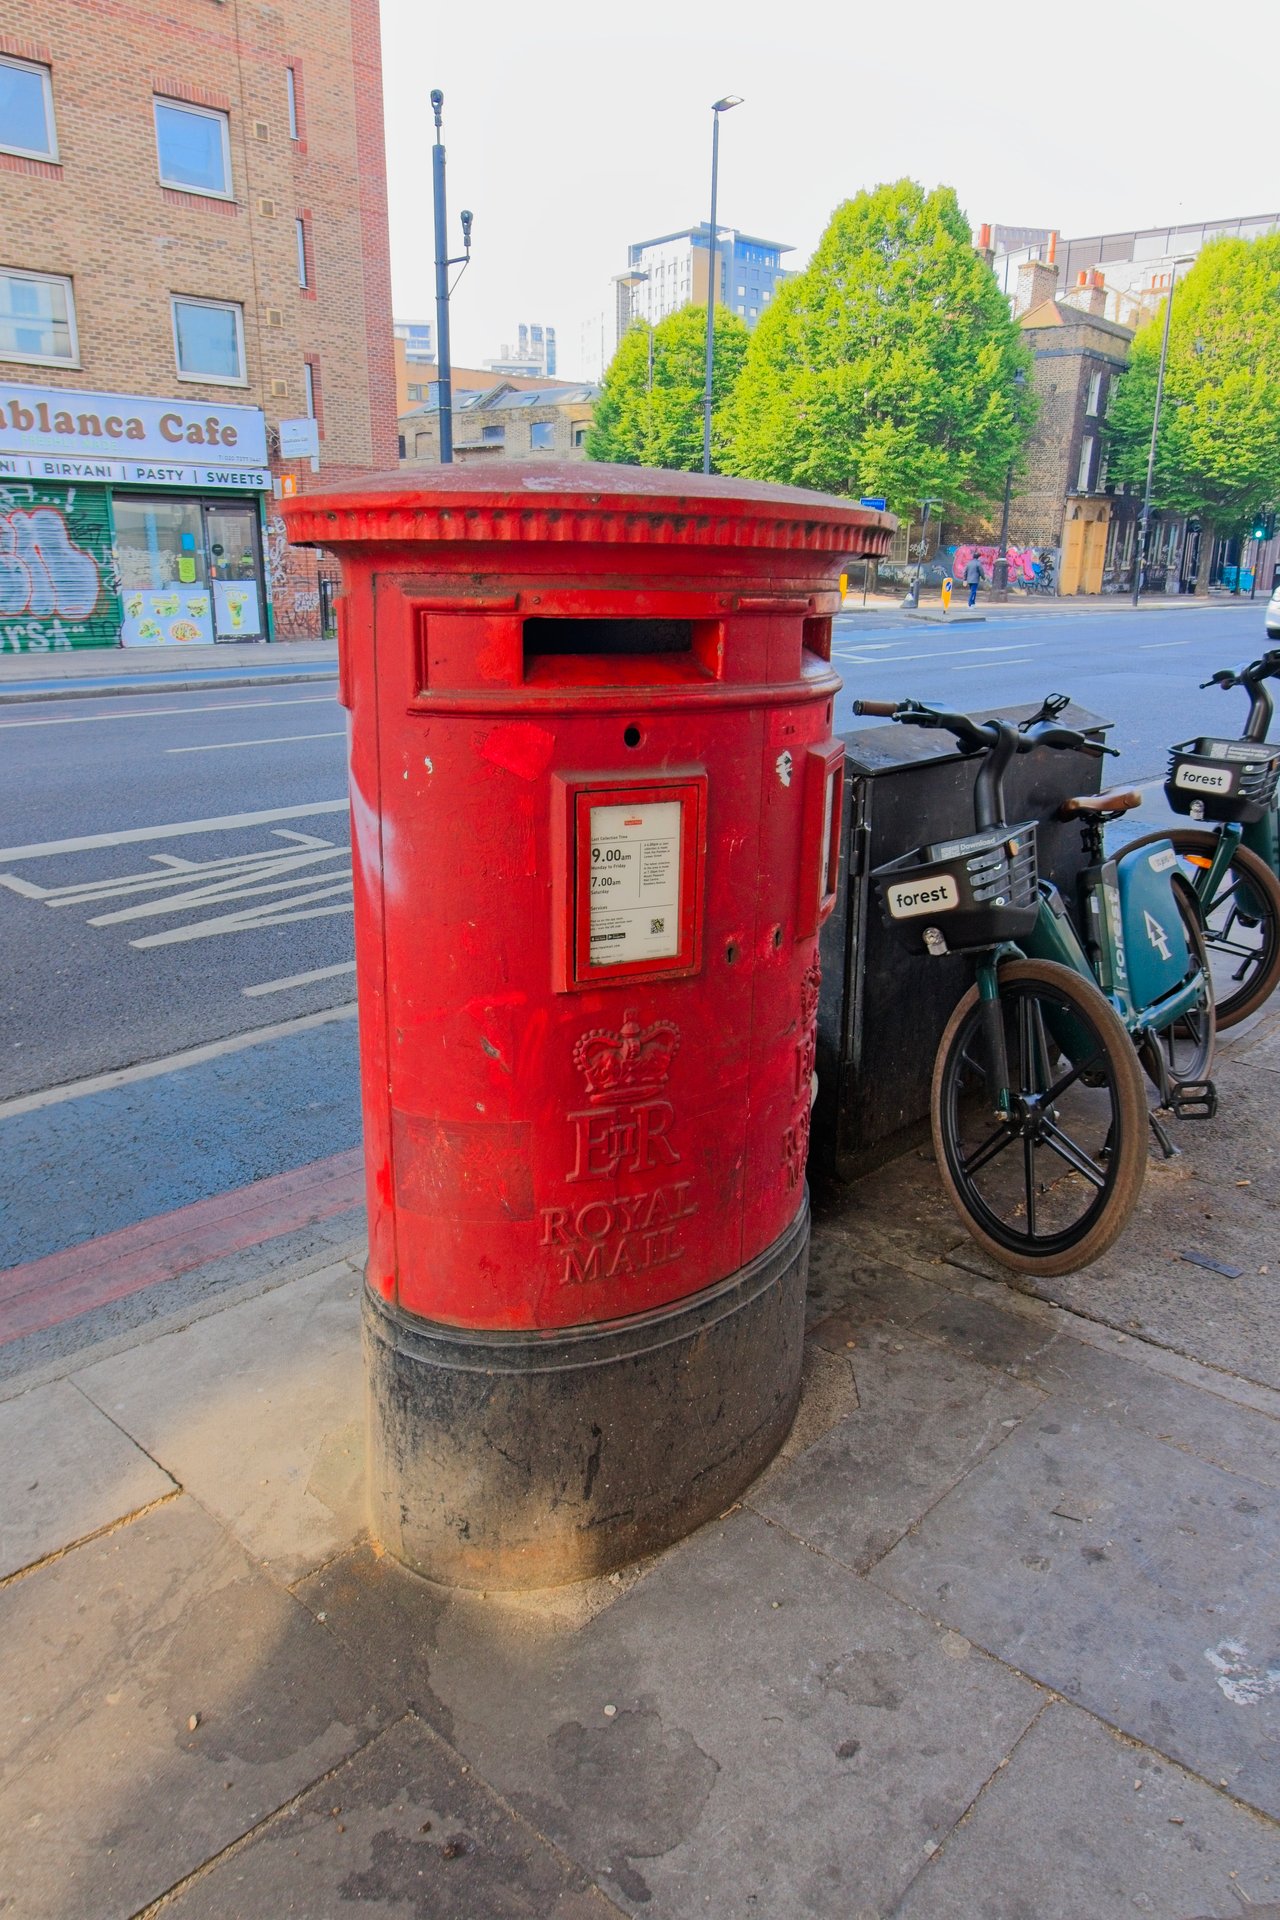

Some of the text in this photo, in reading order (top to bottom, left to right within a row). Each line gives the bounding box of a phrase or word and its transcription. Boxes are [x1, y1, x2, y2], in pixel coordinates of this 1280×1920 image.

[159, 413, 238, 447] Cafe
[44, 462, 112, 477] BIRYANI
[136, 468, 183, 481] PASTY
[207, 472, 264, 485] SWEETS
[1183, 771, 1223, 787] forest
[960, 837, 996, 851] Download
[592, 848, 632, 863] 9.00am
[591, 876, 621, 888] 7.00am
[896, 886, 948, 907] forest
[1108, 888, 1127, 980] forest
[539, 1181, 698, 1246] ROYAL
[559, 1226, 685, 1285] MAIL
